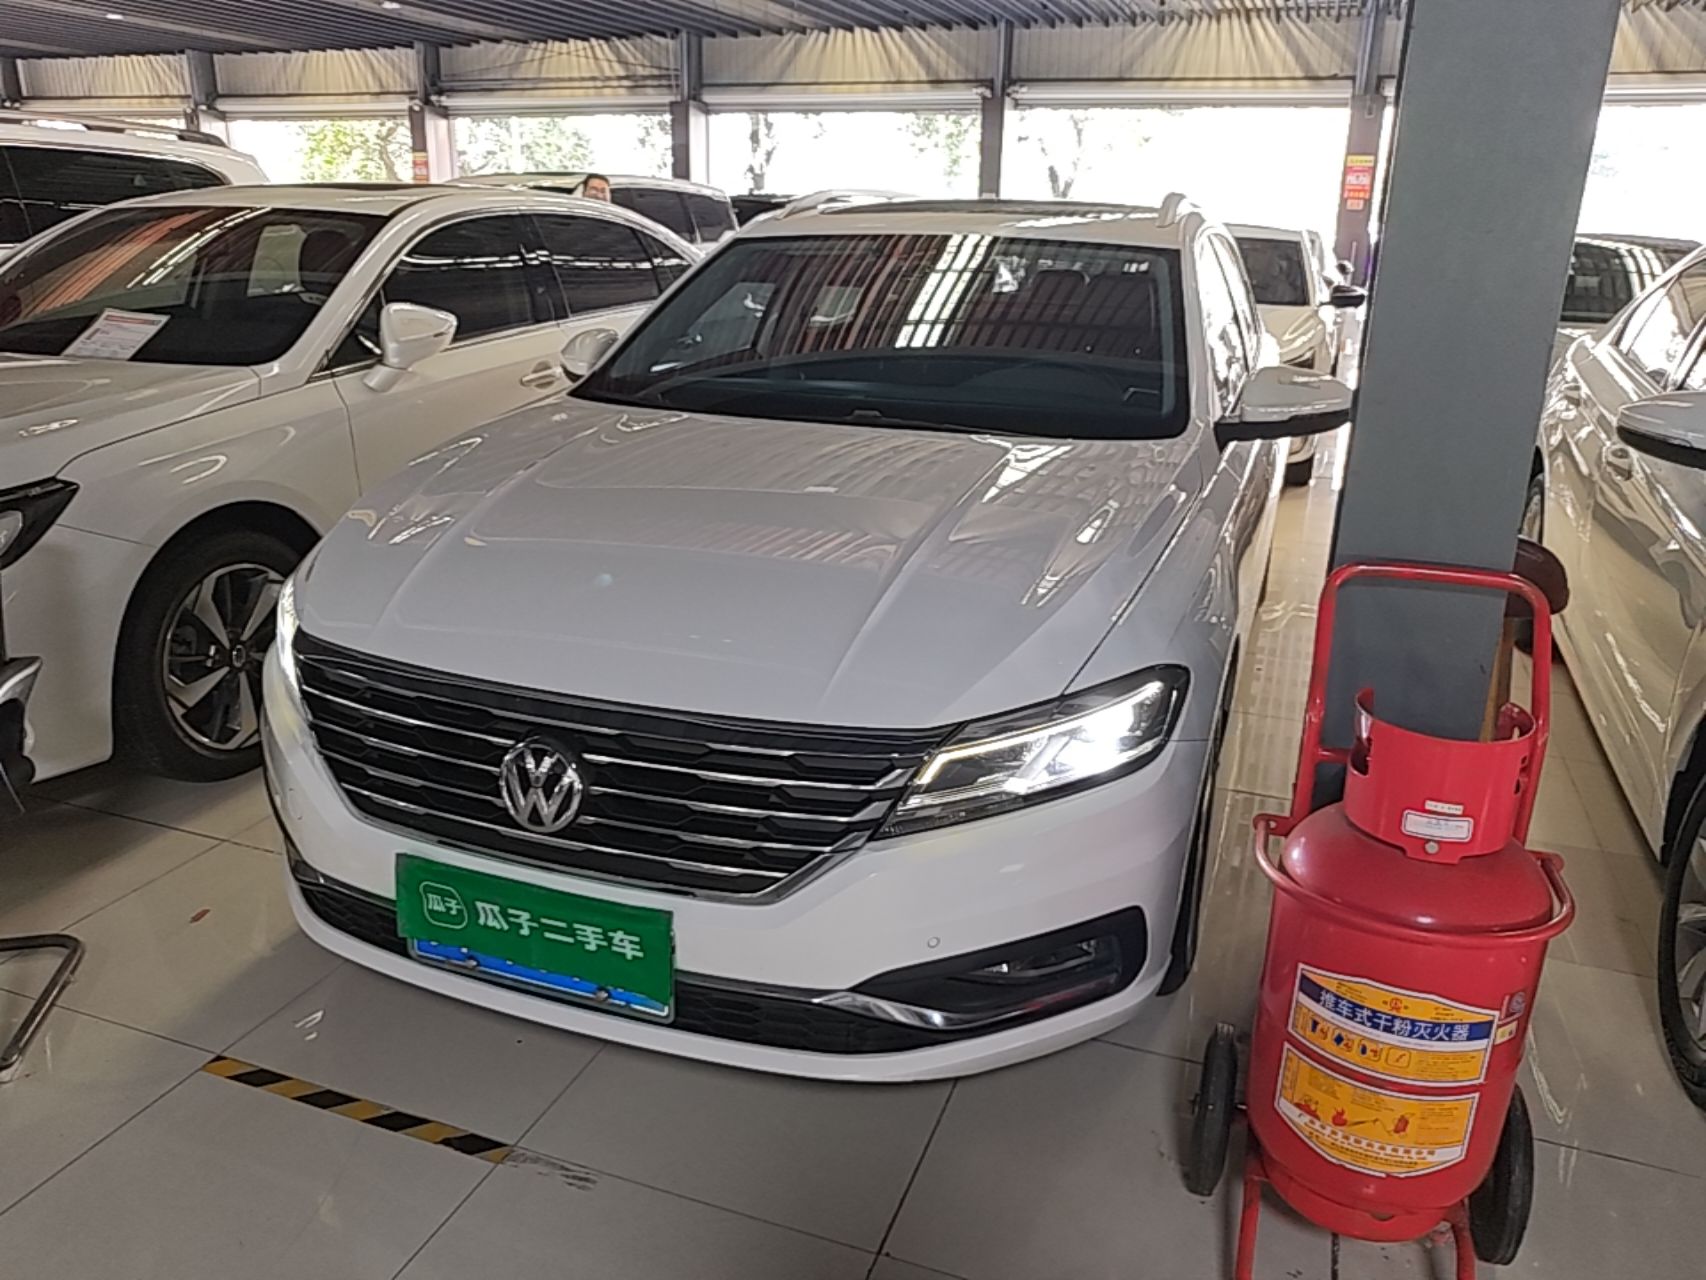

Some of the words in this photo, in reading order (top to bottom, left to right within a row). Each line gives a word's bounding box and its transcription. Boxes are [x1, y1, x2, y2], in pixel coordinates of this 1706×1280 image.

[427, 893, 462, 915] 瓜子
[475, 901, 644, 960] 瓜子二手车
[1320, 991, 1470, 1041] 推车式干粉灭火器
